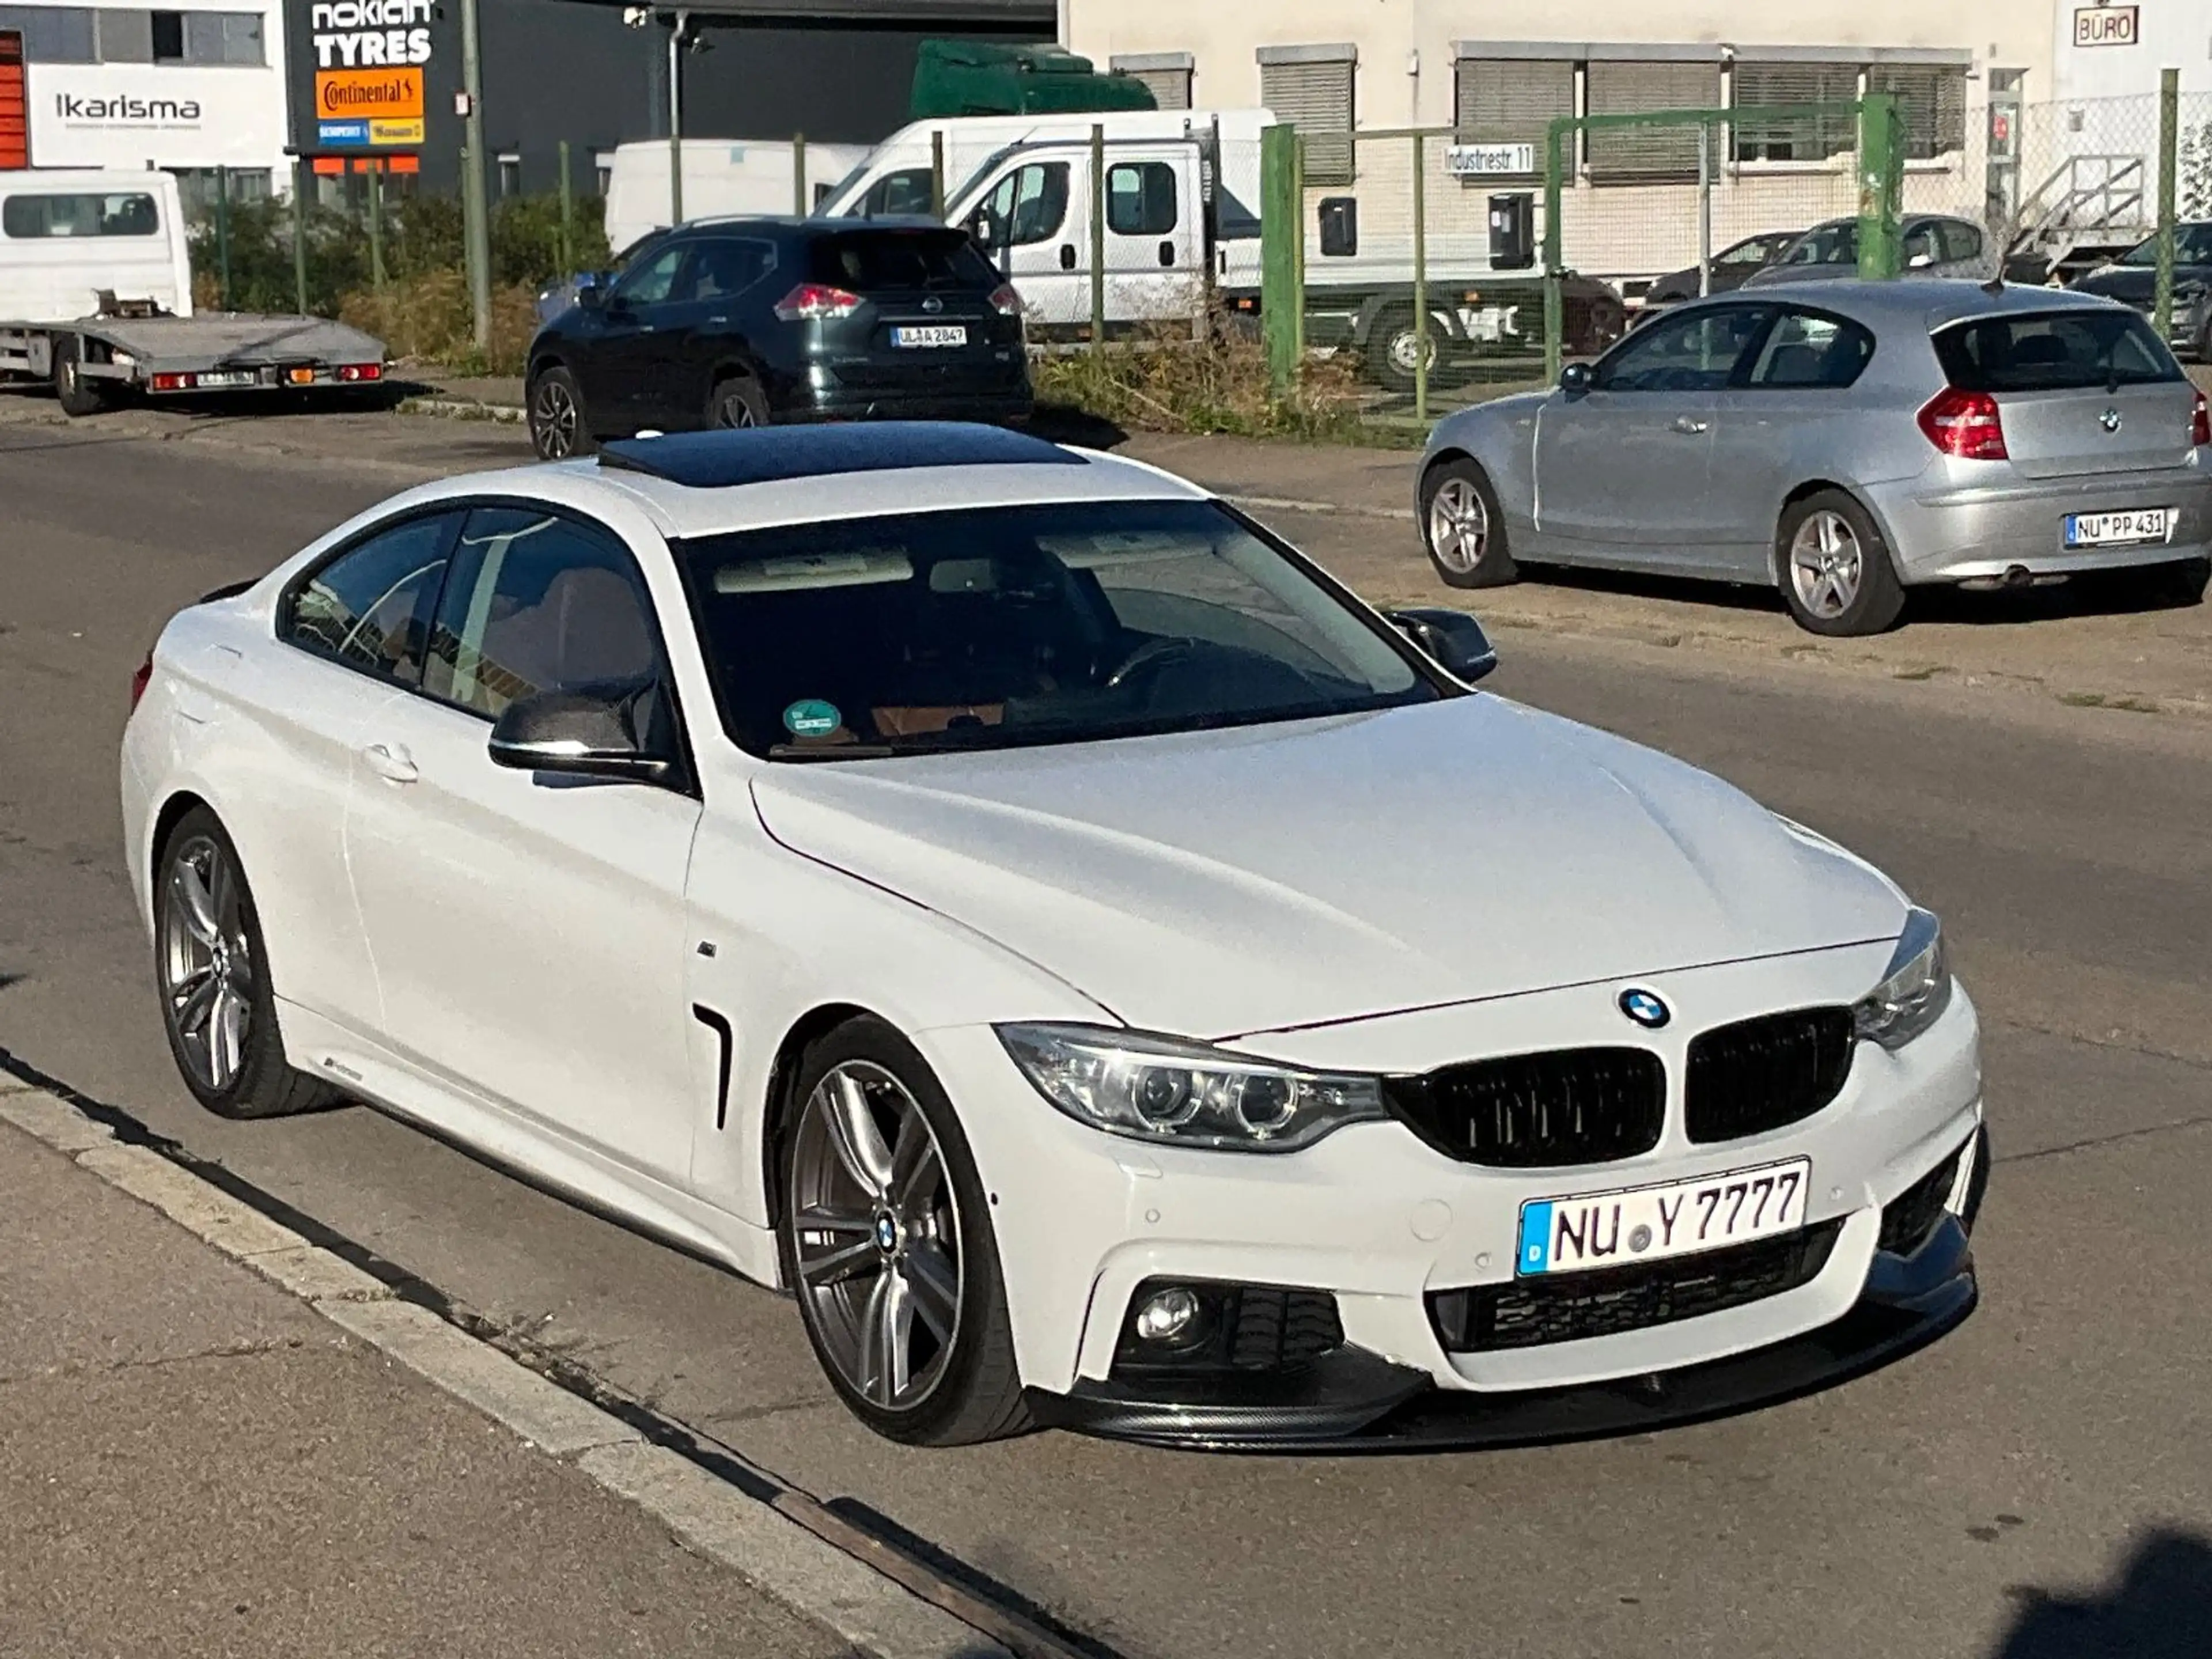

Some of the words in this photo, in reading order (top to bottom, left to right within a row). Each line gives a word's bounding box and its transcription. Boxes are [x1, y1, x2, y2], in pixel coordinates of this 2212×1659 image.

[2080, 14, 2130, 40] BÜRO
[313, 28, 431, 67] TYRES
[324, 79, 401, 111] Continental
[1518, 146, 1531, 171] 11
[2078, 520, 2100, 539] NU
[2112, 516, 2131, 536] PP
[2136, 513, 2162, 533] 431
[1555, 1204, 1621, 1262] NU
[1658, 1194, 1684, 1247] Y
[1696, 1171, 1801, 1240] 7777
